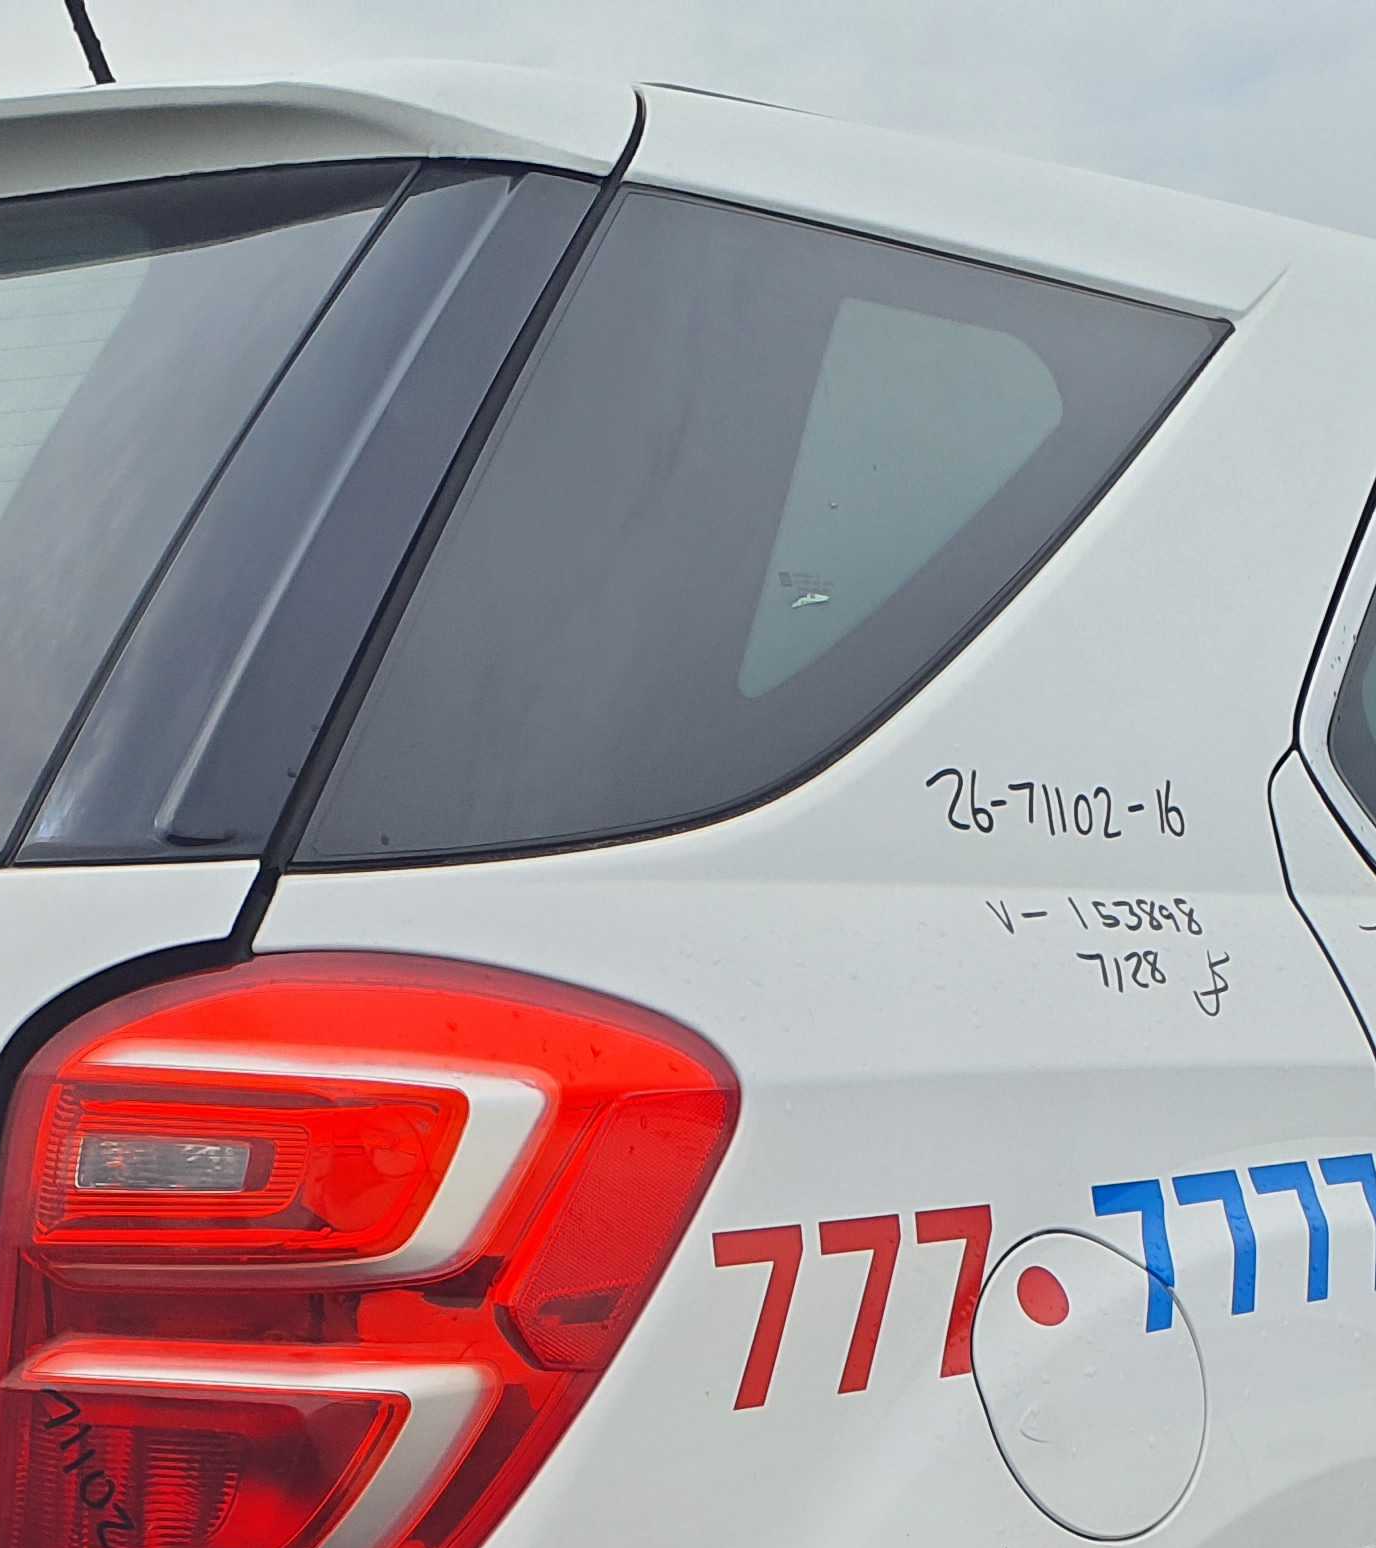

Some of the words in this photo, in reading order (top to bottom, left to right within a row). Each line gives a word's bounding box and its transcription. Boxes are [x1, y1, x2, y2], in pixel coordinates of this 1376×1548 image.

[925, 768, 1185, 839] 26-71102-16
[1075, 950, 1167, 993] 7128
[711, 1204, 993, 1411] 777
